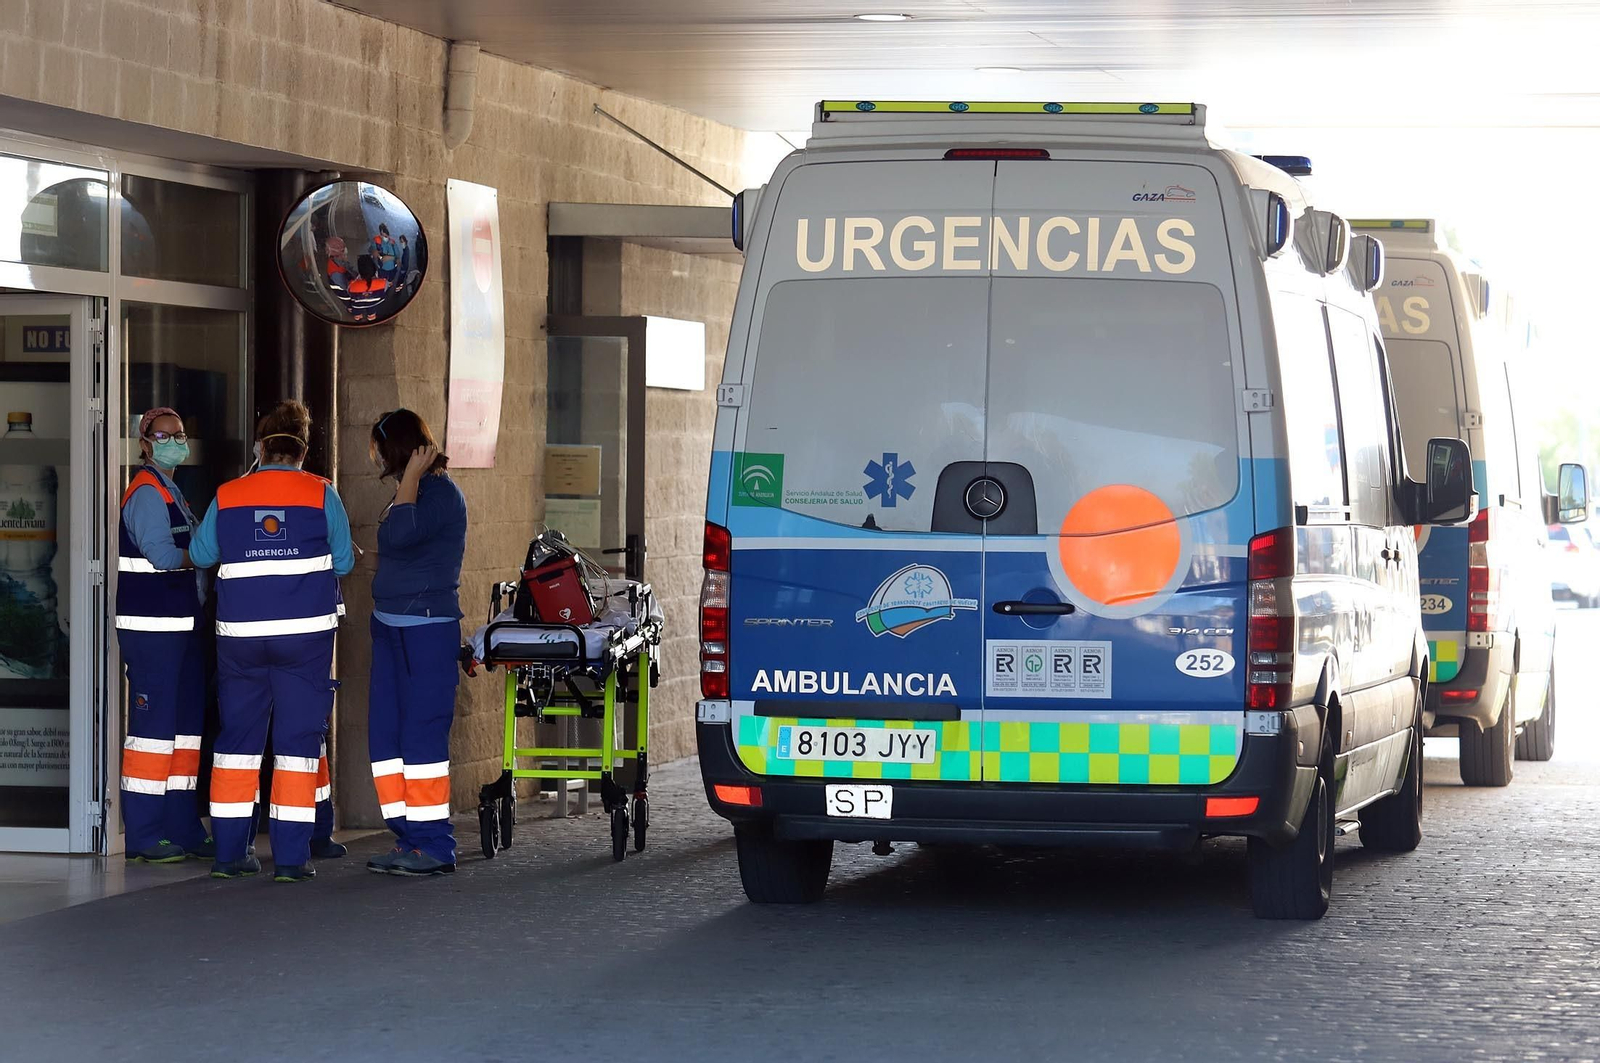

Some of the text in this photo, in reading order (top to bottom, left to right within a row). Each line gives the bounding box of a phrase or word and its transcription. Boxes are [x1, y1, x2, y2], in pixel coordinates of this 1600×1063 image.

[1132, 193, 1165, 202] GAZA
[796, 215, 1196, 274] URGENCIAS
[26, 330, 50, 349] NO
[245, 548, 299, 558] URGENCIAS
[1420, 598, 1446, 610] 234
[743, 618, 834, 627] SPRINTER
[1167, 627, 1199, 636] 314
[1186, 654, 1224, 671] 252
[751, 669, 958, 696] AMBULANCIA
[782, 745, 788, 753] E
[798, 730, 931, 759] 8103 JYY
